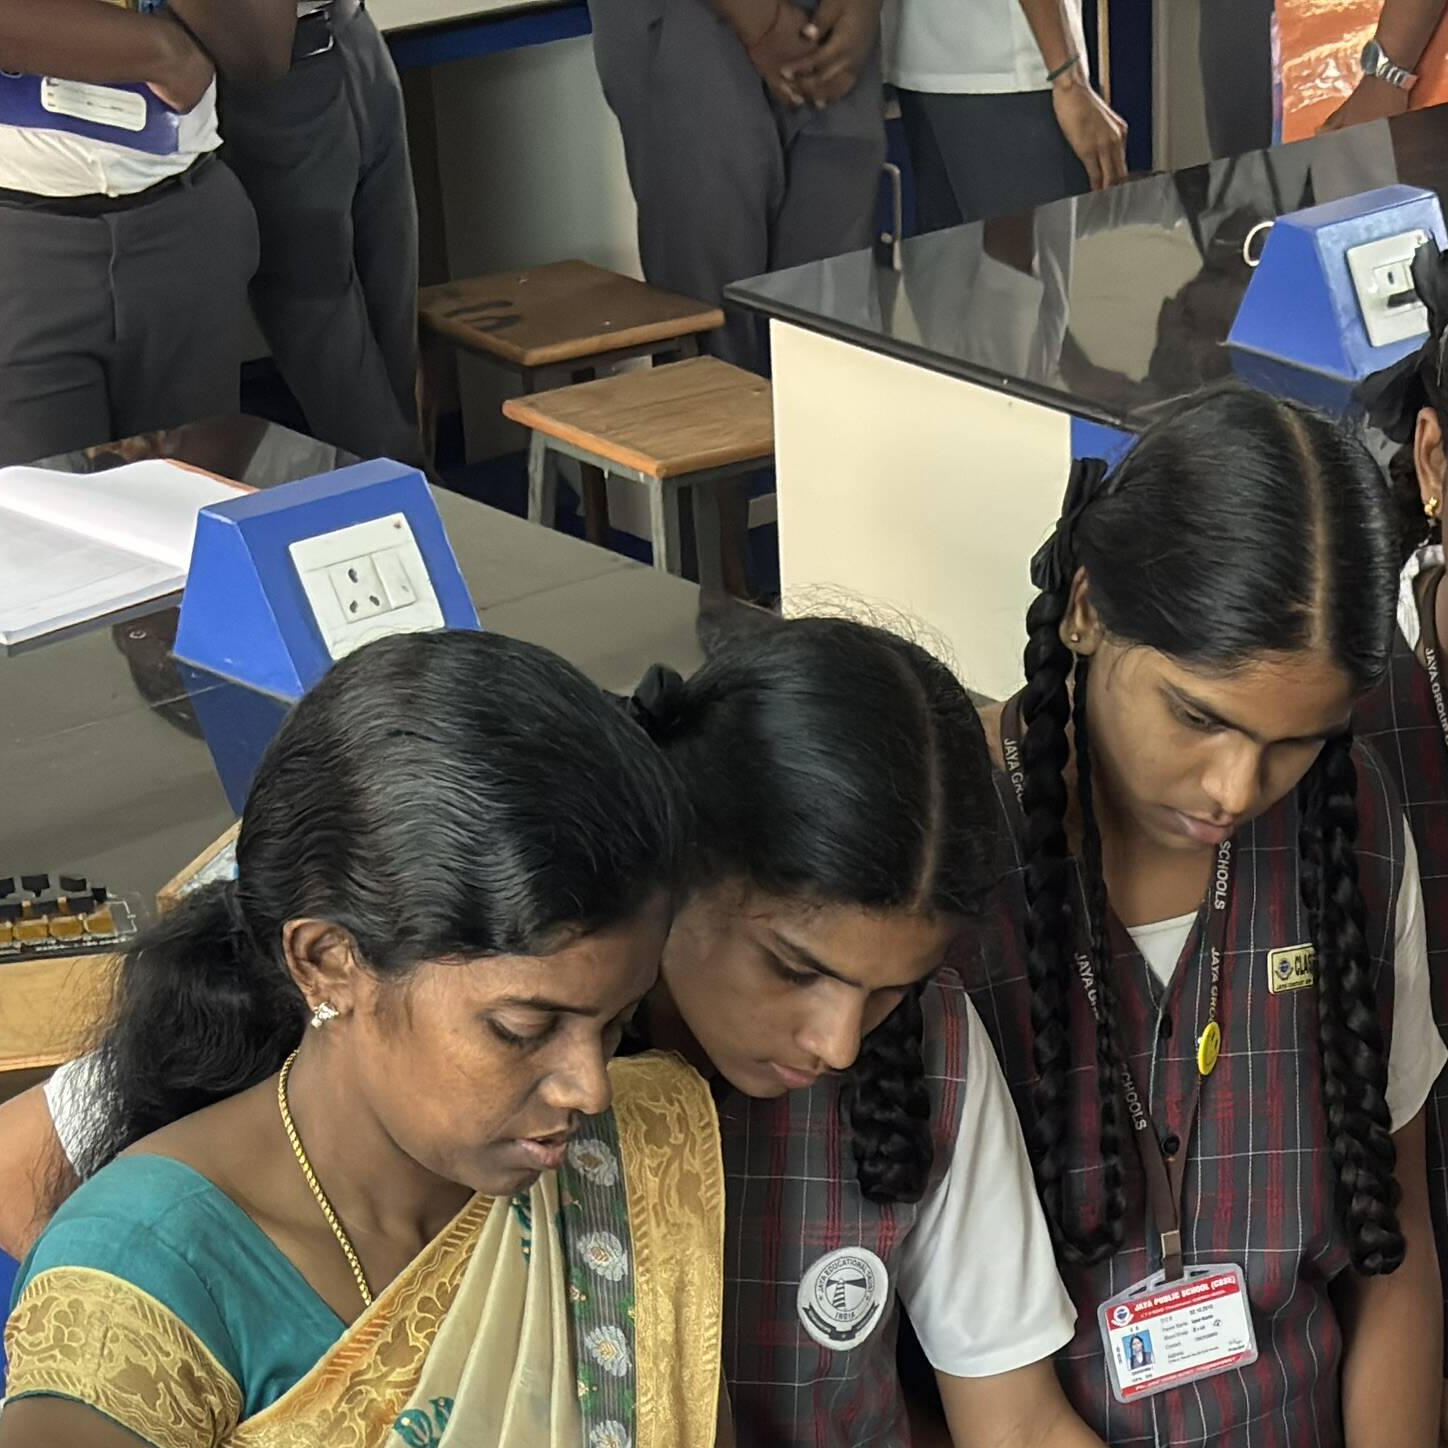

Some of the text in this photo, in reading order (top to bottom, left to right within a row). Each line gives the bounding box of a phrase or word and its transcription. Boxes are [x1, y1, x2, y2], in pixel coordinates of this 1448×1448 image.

[1425, 647, 1438, 682] JAYA
[1003, 738, 1022, 773] JAYA
[1213, 839, 1231, 911] SCHOOLS
[1074, 951, 1091, 989] JAYA
[1210, 946, 1222, 984] JAYA
[1134, 1300, 1153, 1312] JAYA
[1153, 1292, 1181, 1305] PUBLIC
[1181, 1283, 1210, 1298] SCHOOL
